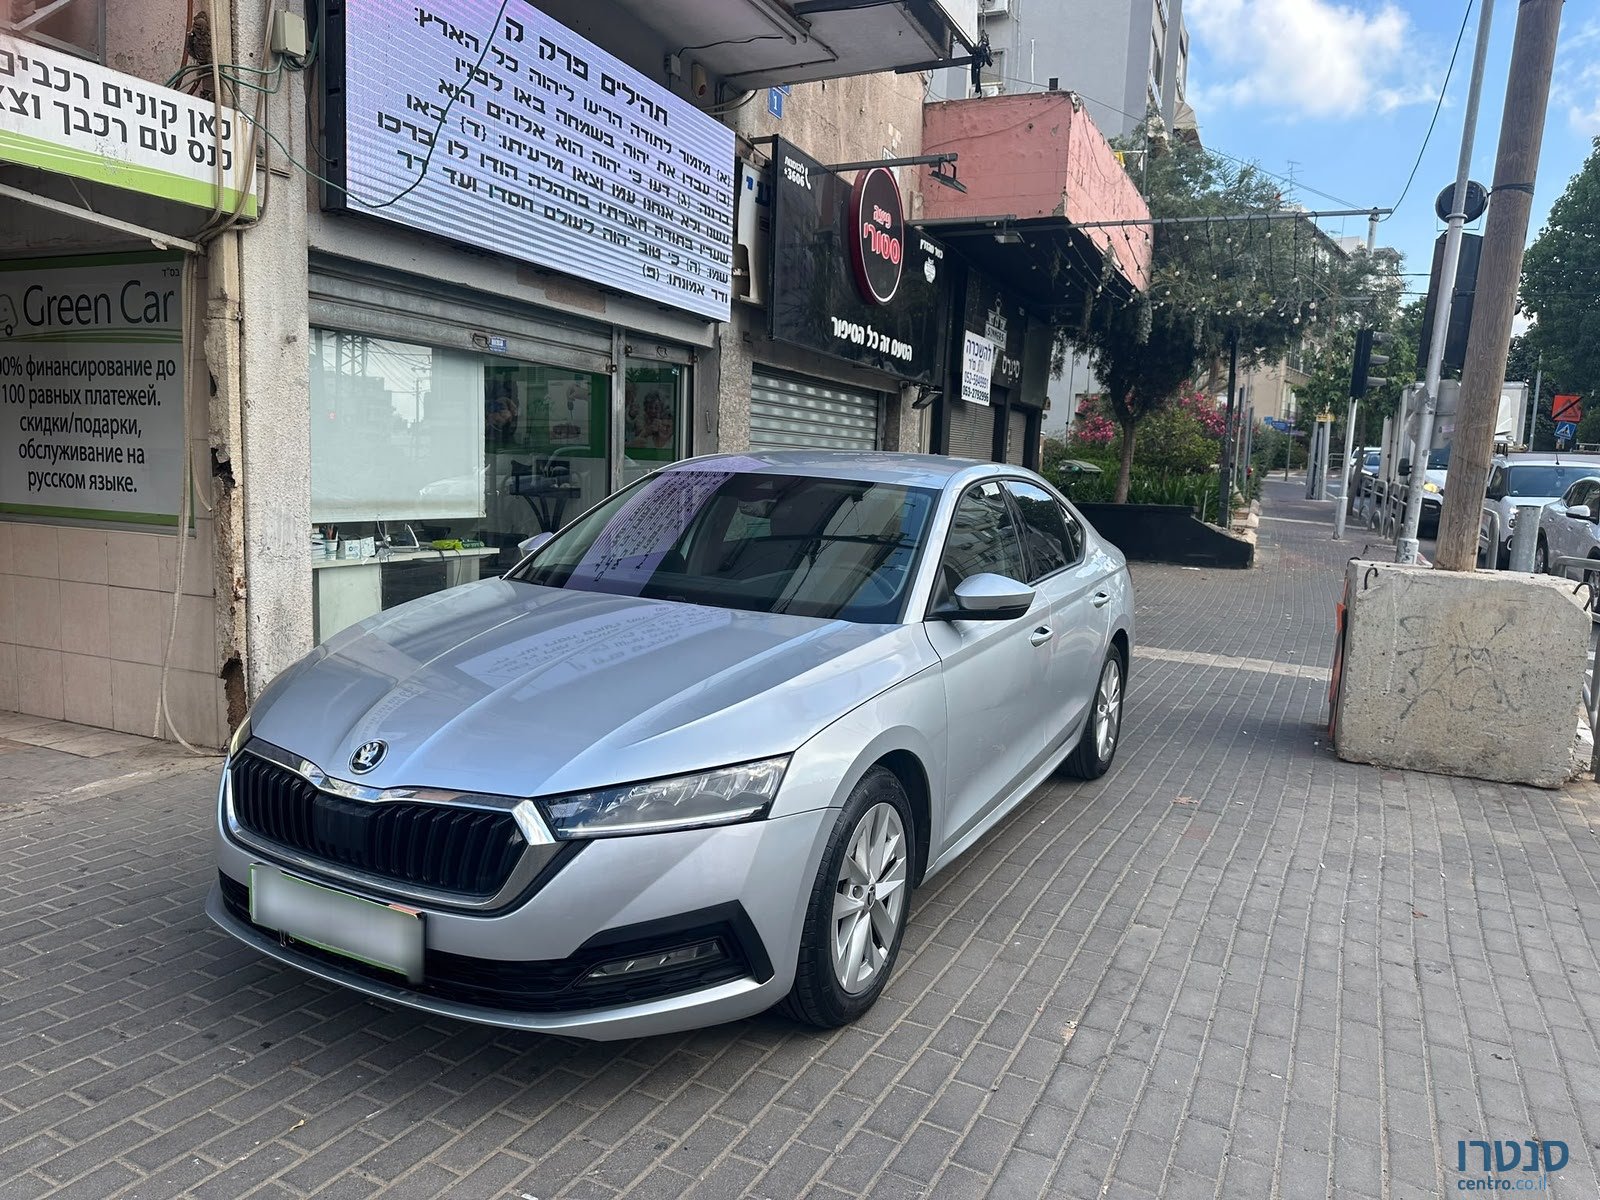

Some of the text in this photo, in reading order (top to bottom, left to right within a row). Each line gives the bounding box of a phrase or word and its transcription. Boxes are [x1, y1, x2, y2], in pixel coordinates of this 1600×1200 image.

[414, 7, 479, 53] הארץ:
[491, 45, 518, 73] כל
[506, 16, 668, 127] תהילים פרק ק
[455, 57, 503, 92] לפניו
[529, 67, 575, 102] ליהוה
[0, 49, 231, 140] כאן קונים רכבים
[438, 78, 475, 108] הוא
[514, 86, 546, 115] באו
[406, 93, 447, 124] באו
[486, 101, 546, 141] אלהים
[583, 97, 623, 129] הריעו
[0, 84, 232, 171] כנס עם רכבך וצ
[556, 107, 615, 149] בשמחה
[630, 122, 672, 154] לתודה
[498, 134, 564, 173] מרעיתו:
[555, 133, 584, 158] הוא
[622, 142, 649, 164] יהוה
[397, 150, 429, 174] דר
[592, 150, 621, 174] יהוה
[656, 160, 676, 179] את
[678, 149, 711, 176] מזמור
[377, 111, 729, 265] שעריו בתודה חצרתיו בתהלה הודו לו ברכו
[442, 166, 477, 193] ועד
[572, 165, 604, 192] וצאן
[629, 168, 642, 184] כי
[649, 178, 671, 198] דעו
[682, 172, 710, 196] עבדו
[488, 184, 534, 213] חסדו
[612, 183, 636, 204] עמו
[543, 204, 595, 234] לעולם
[643, 197, 674, 221] אנחנו
[696, 201, 730, 226] ברננה:
[681, 213, 701, 233] ולא
[706, 225, 730, 245] עשנו
[602, 227, 631, 247] יהוה
[638, 240, 661, 260] טוב
[863, 222, 900, 264] סטורי
[668, 252, 680, 266] כי
[666, 273, 705, 296] אמונתו:
[706, 267, 729, 284] שמו:
[23, 279, 175, 327] Green Car
[711, 288, 728, 304] ודר
[831, 316, 864, 345] הסיפור
[866, 325, 879, 349] כל
[880, 334, 890, 353] זה
[966, 339, 992, 361] להשכרה
[0, 354, 176, 381] 0% финансирование до
[2, 384, 162, 409] 100 равных платежей.
[19, 412, 143, 440] скидки/подарки,
[18, 437, 145, 466] обслуживание на
[28, 470, 138, 493] русском языке.
